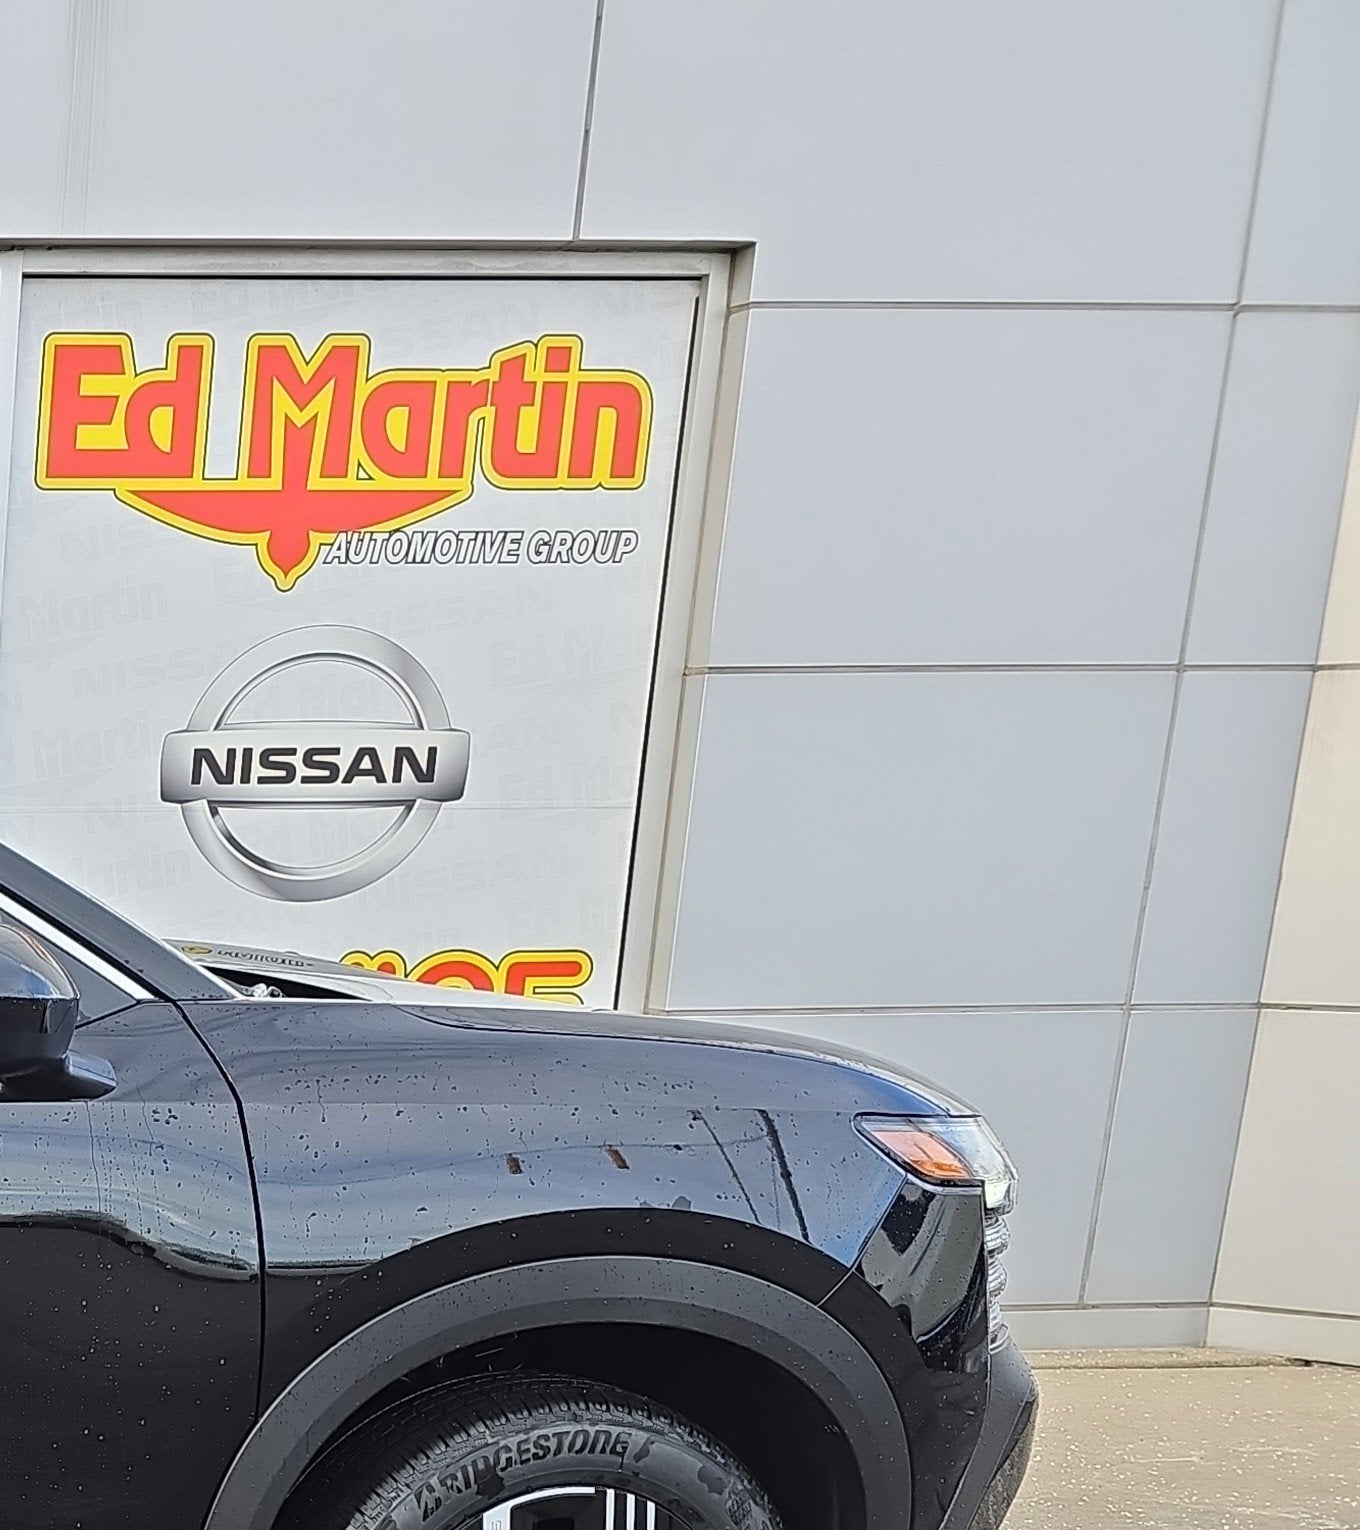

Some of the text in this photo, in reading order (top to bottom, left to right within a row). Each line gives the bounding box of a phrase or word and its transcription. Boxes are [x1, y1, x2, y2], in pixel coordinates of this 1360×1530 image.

[37, 333, 652, 489] Ed Martin
[324, 529, 639, 564] AUTOMOTIVE GROUP
[190, 745, 439, 786] NISSAN
[413, 1428, 632, 1523] BRIDGESTONE
